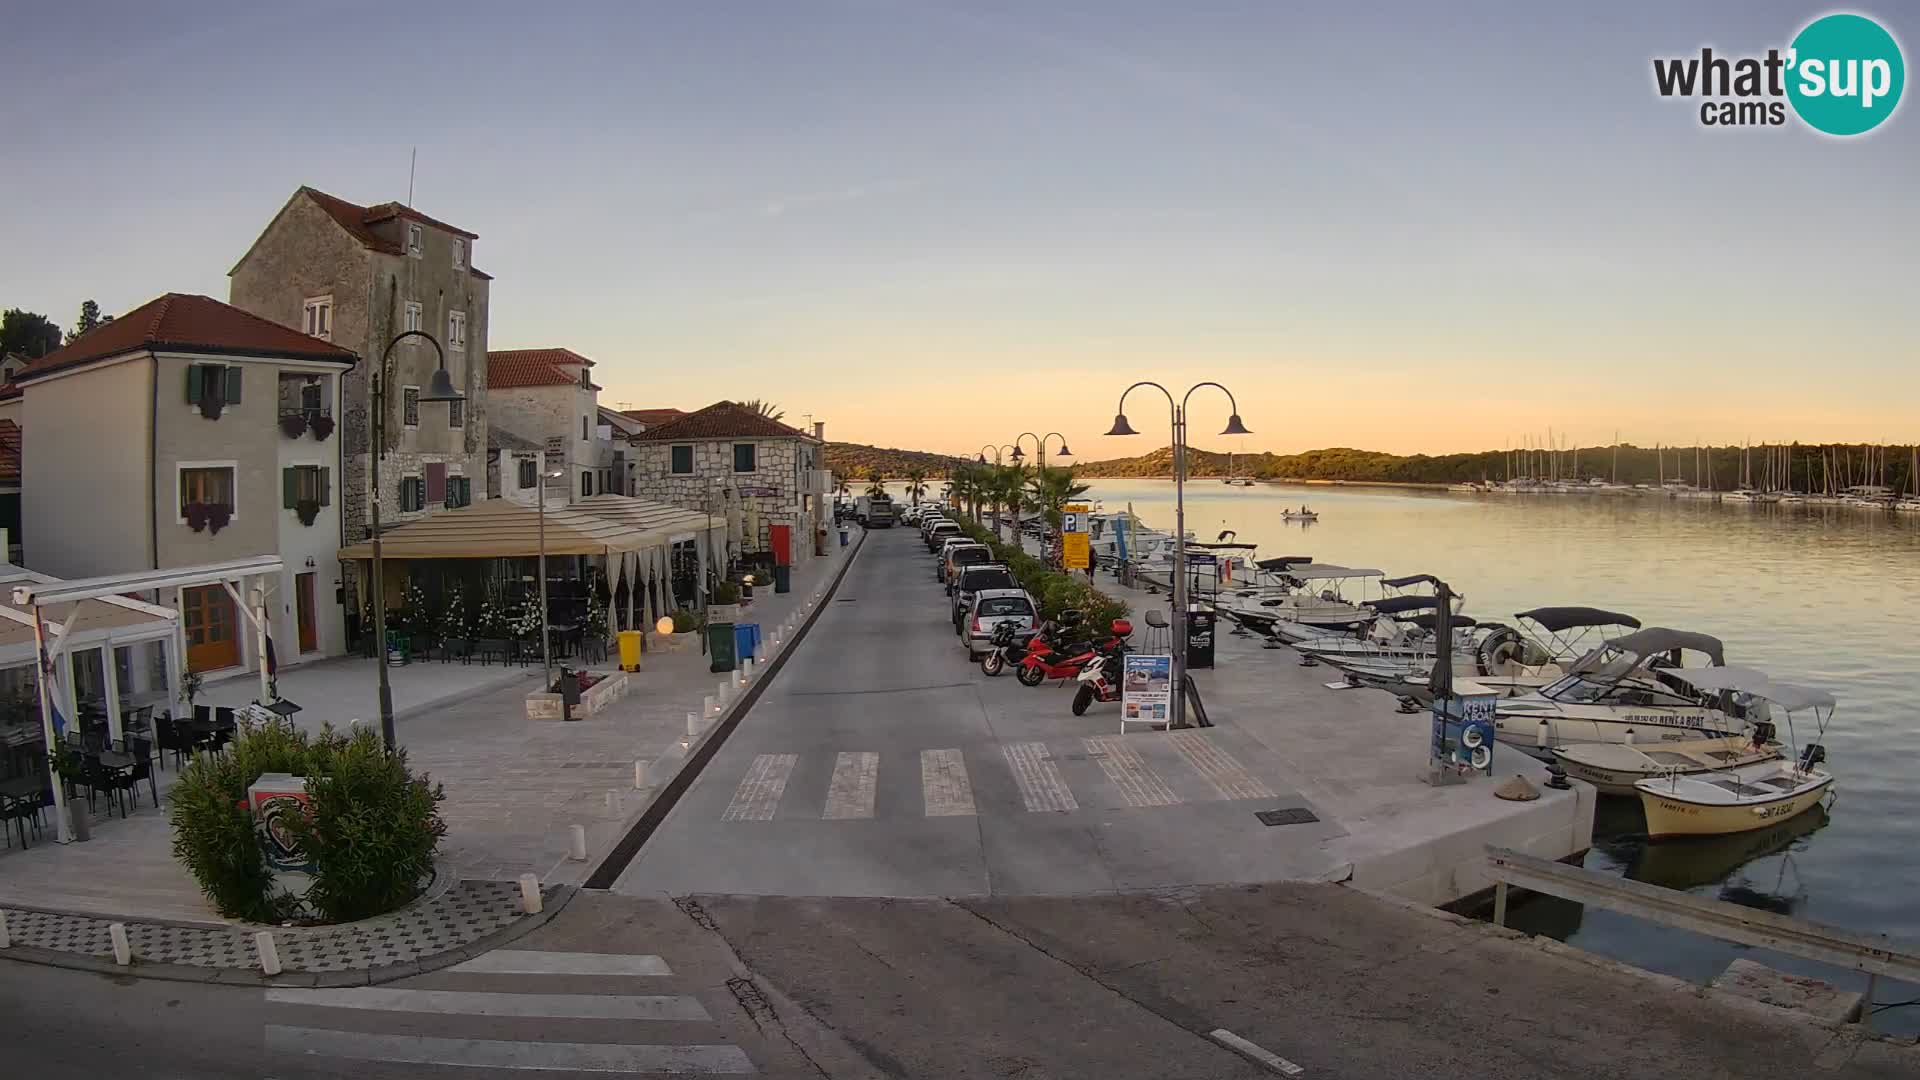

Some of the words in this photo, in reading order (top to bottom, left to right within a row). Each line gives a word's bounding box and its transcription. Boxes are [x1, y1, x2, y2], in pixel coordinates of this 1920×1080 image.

[1463, 702, 1494, 713] RENT
[1463, 713, 1469, 721] A
[1659, 715, 1679, 726] RENT
[1679, 716, 1685, 727] A
[1686, 716, 1705, 728] BOAT
